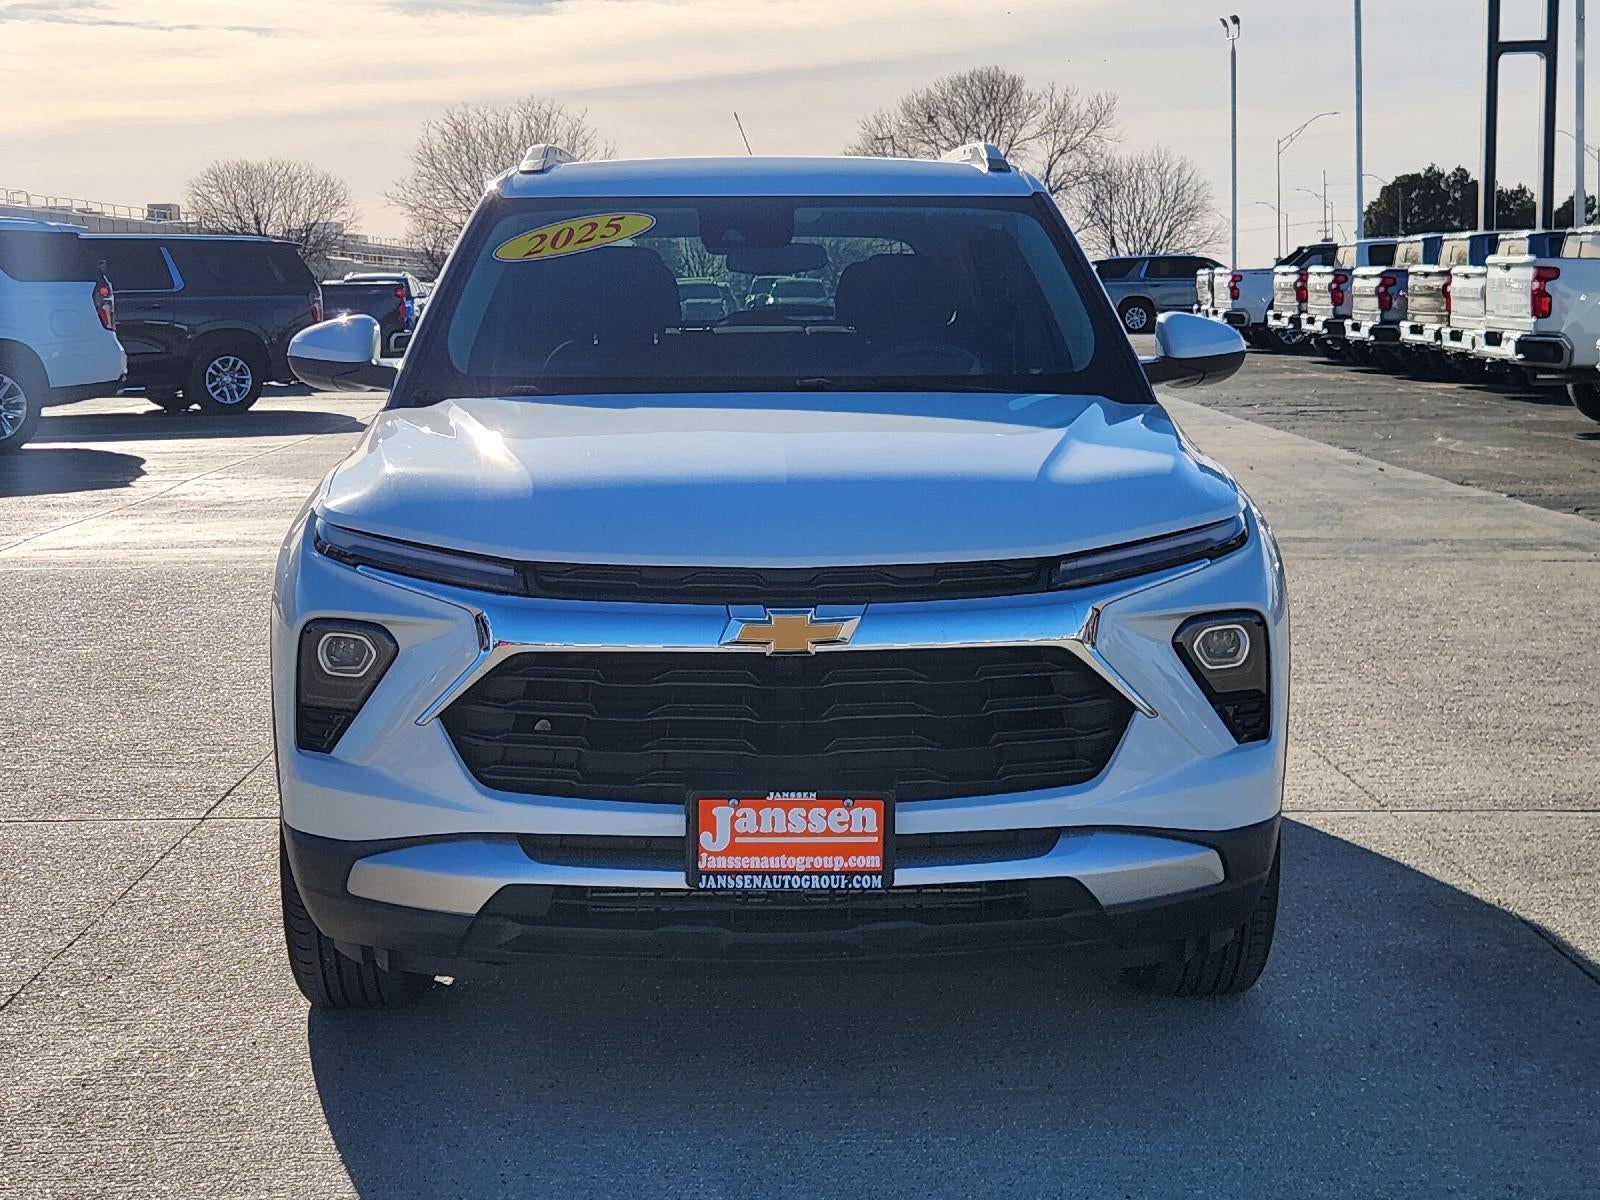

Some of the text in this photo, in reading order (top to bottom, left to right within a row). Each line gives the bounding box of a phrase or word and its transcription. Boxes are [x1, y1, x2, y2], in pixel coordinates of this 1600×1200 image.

[523, 216, 626, 257] 2025
[766, 791, 817, 800] JANSSEN
[700, 806, 878, 851] Janssen
[698, 853, 880, 871] Janssenautogroup.com
[699, 874, 882, 889] JANSSENAUTOGROUP.COM
